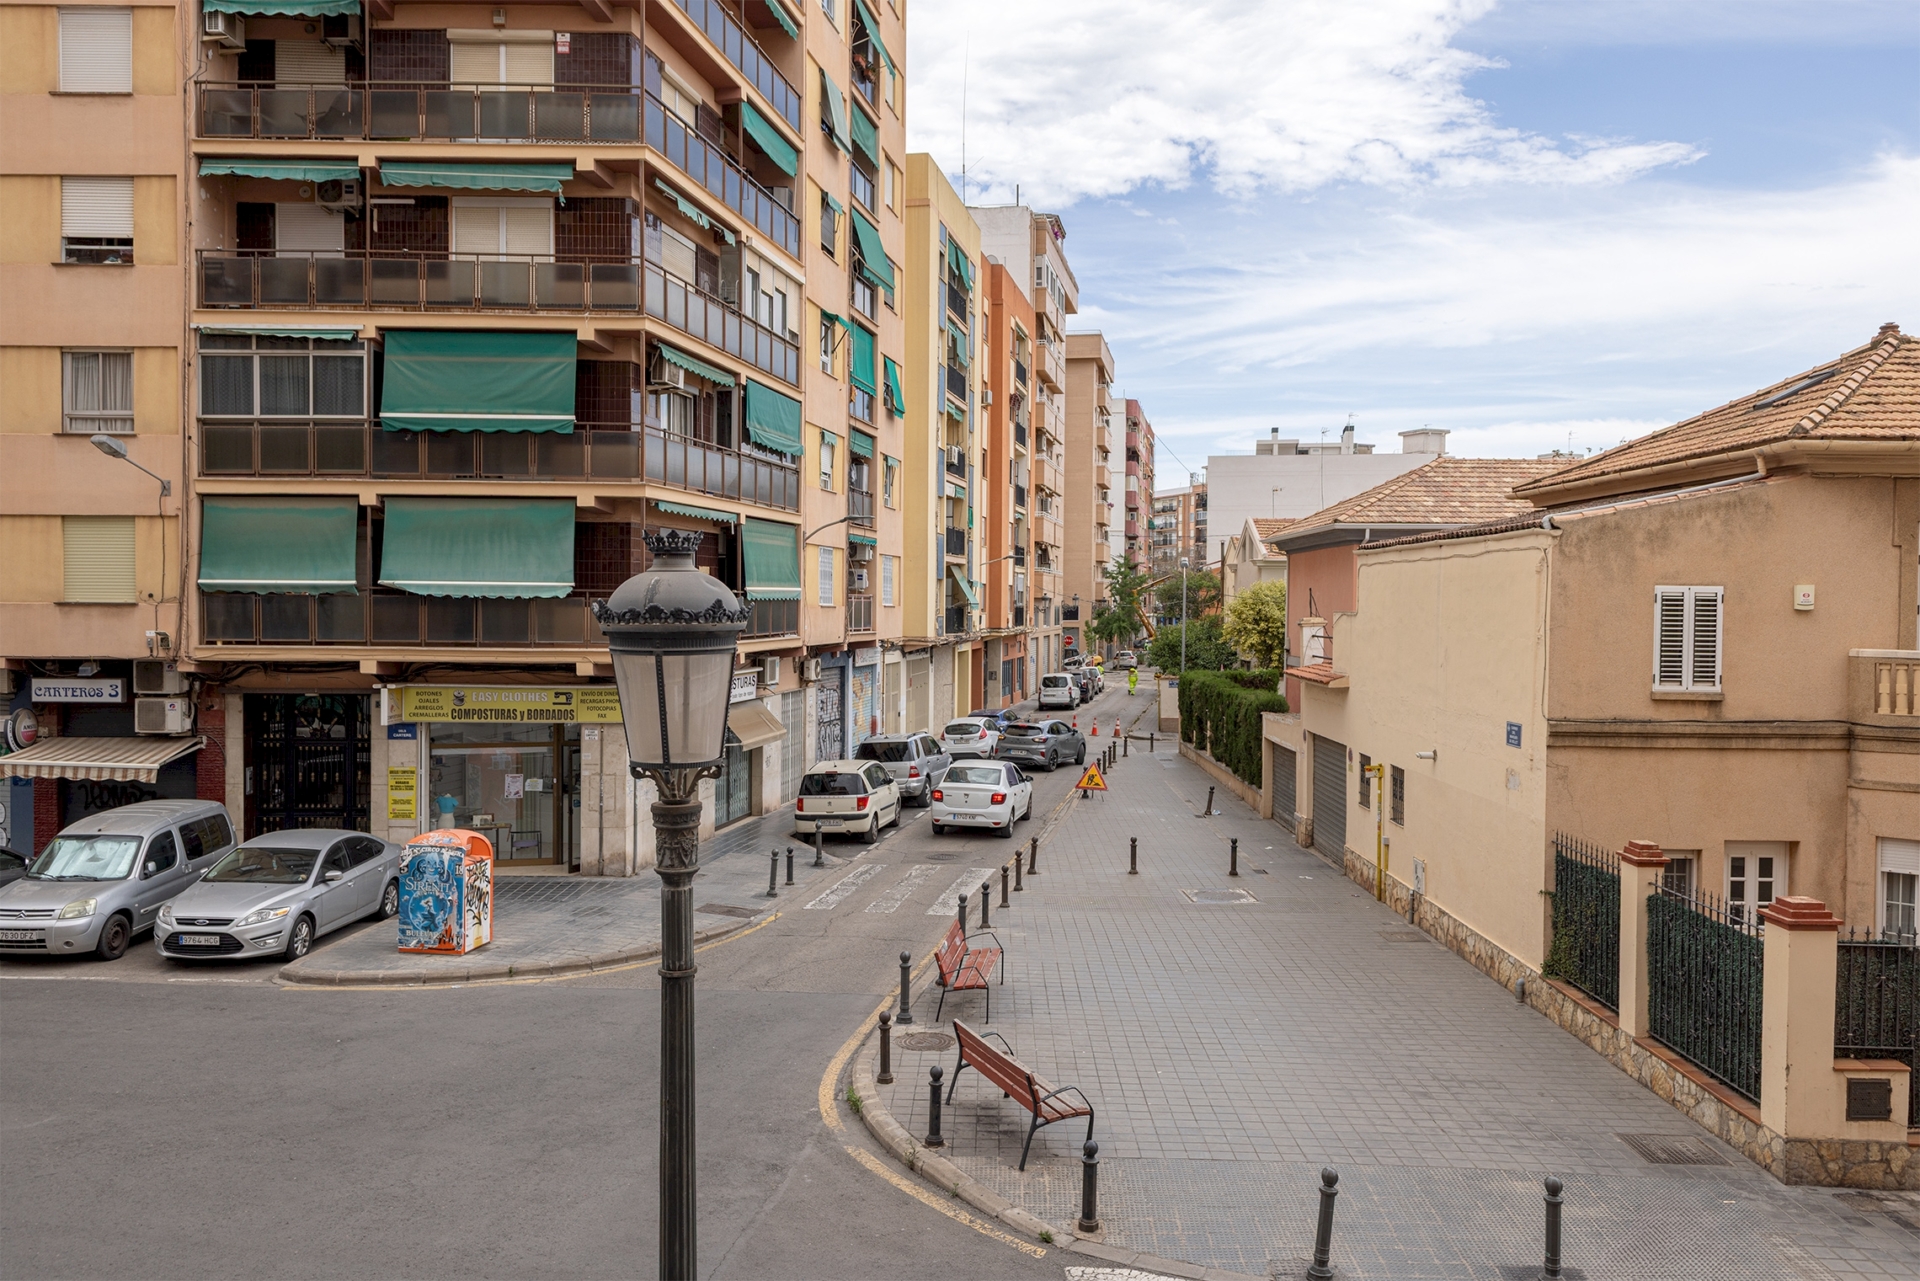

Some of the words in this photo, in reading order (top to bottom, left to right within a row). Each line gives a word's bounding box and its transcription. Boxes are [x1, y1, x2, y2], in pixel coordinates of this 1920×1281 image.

[731, 675, 756, 690] STURAS
[34, 686, 104, 698] CARTEROS
[108, 684, 119, 698] 3
[472, 691, 499, 702] EASY
[501, 691, 548, 703] CLOTHES
[451, 708, 518, 720] COMPOSTURAS
[519, 711, 525, 721] y
[526, 708, 575, 721] BORDADOS
